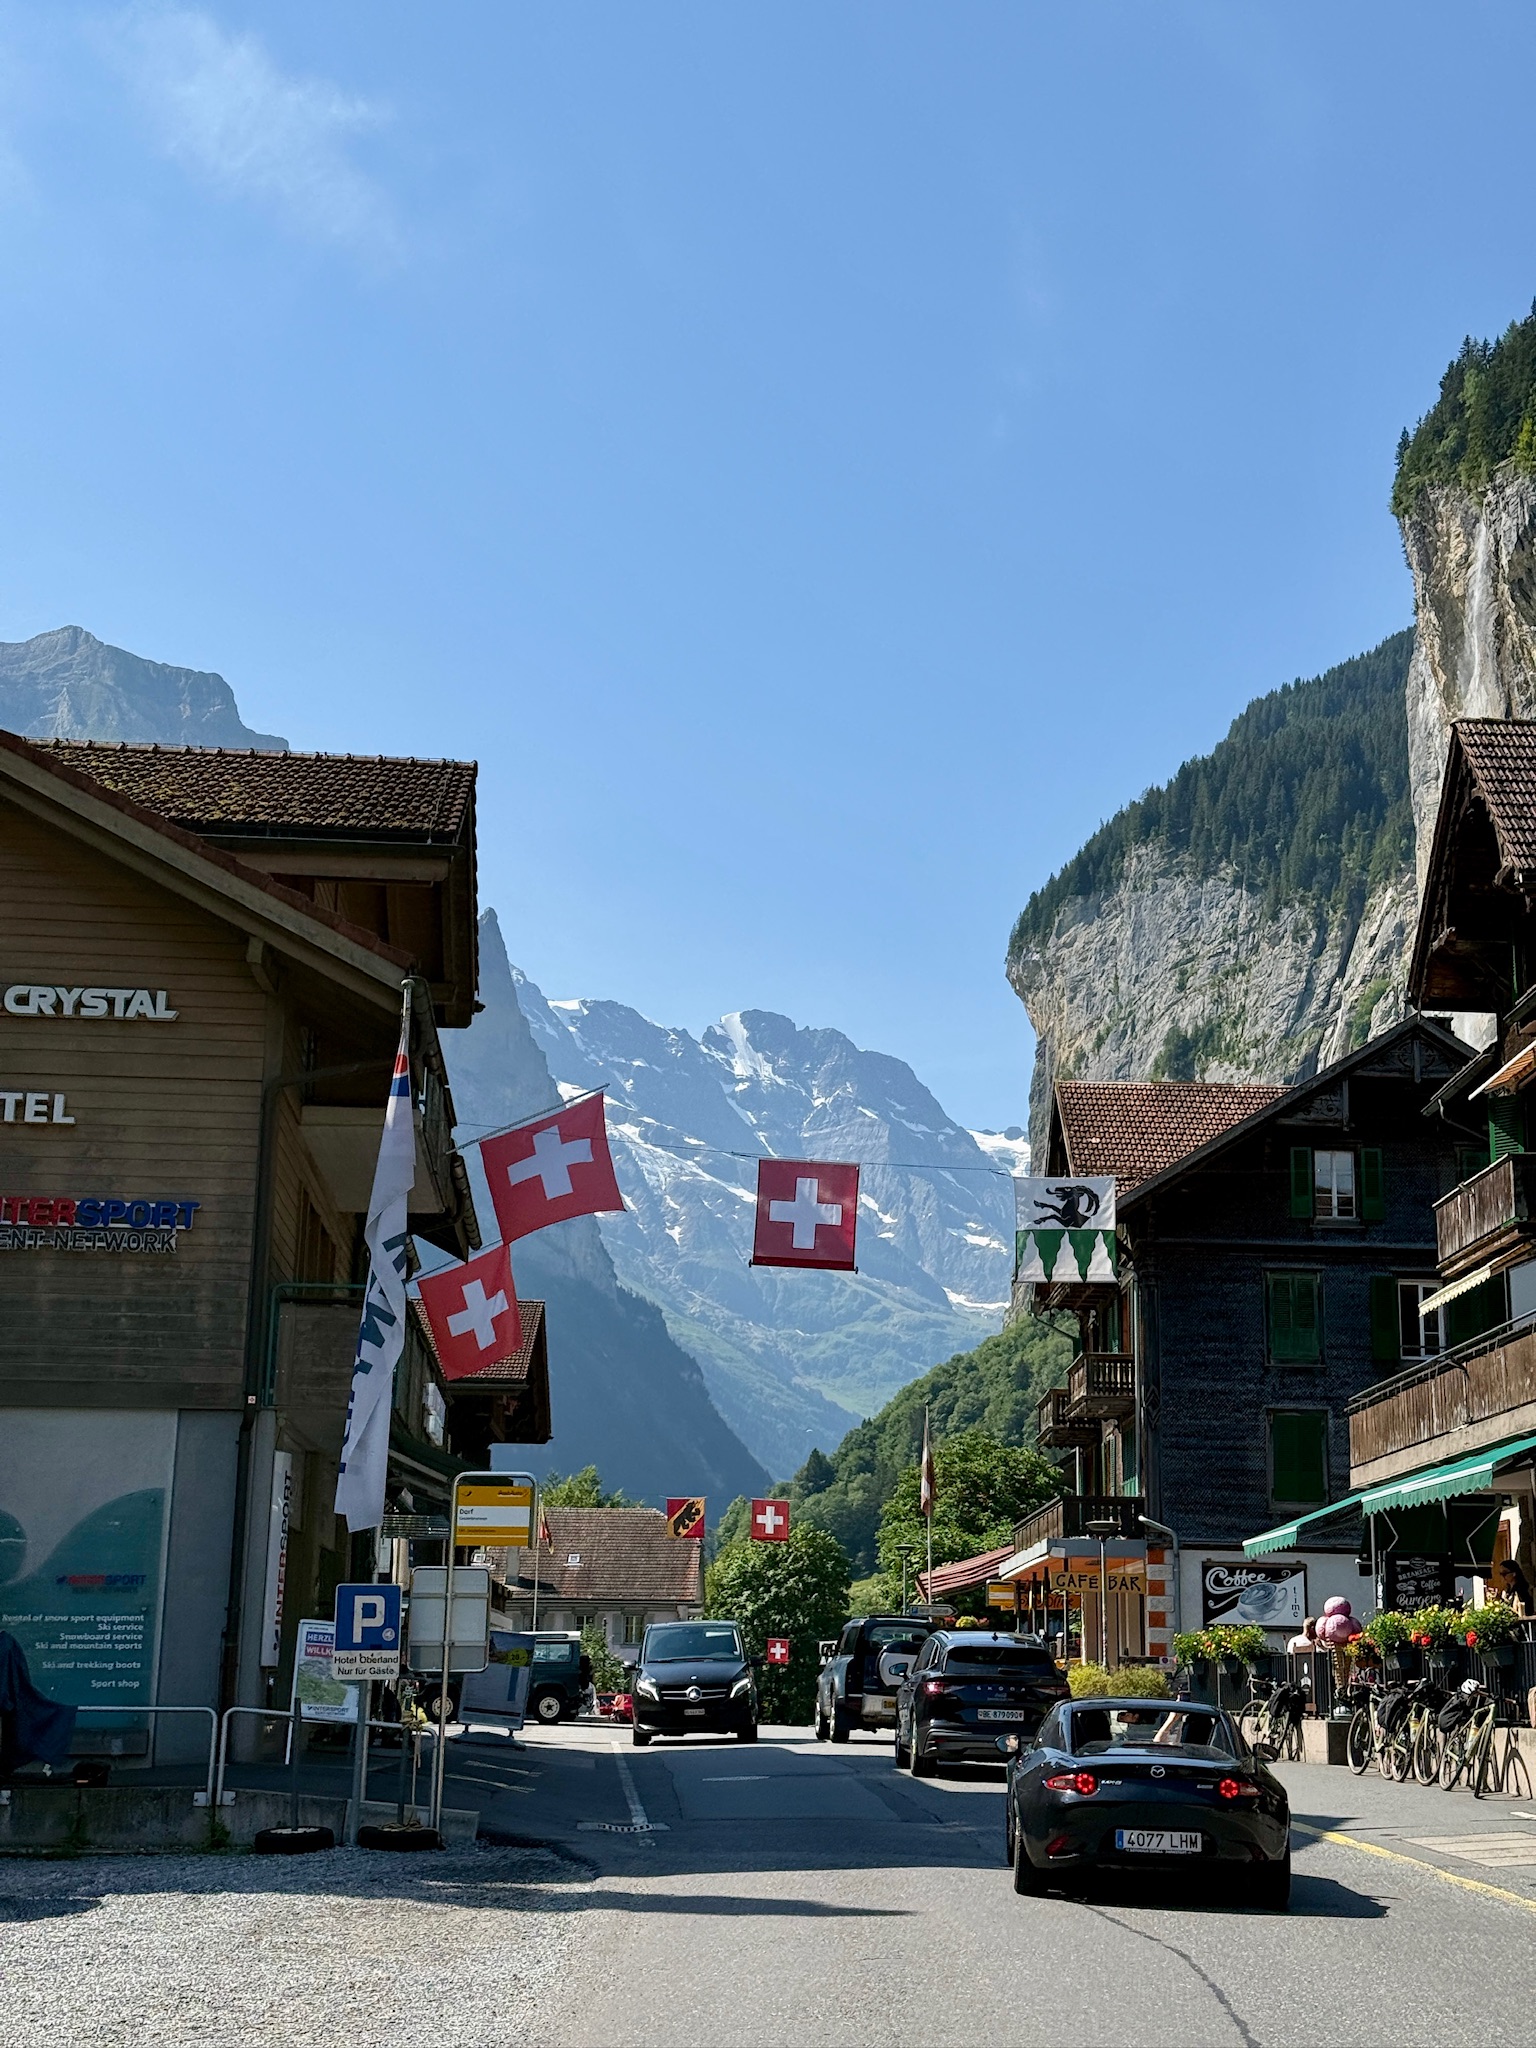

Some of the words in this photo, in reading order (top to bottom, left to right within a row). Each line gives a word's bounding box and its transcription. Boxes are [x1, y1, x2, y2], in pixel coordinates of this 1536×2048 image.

[4, 985, 179, 1021] CRYSTAL
[0, 1092, 76, 1124] TEL
[275, 1470, 292, 1625] INTERSPORT
[1056, 1574, 1099, 1589] CAFÉ
[1108, 1575, 1141, 1591] BAR
[1206, 1567, 1271, 1594] Coffee
[1421, 1579, 1441, 1590] Coffee
[1291, 1586, 1300, 1618] time
[1396, 1593, 1442, 1608] Burgers
[70, 1614, 94, 1623] sport
[96, 1614, 144, 1623] equipment
[352, 1595, 386, 1643] P
[307, 1633, 332, 1642] HERZL
[114, 1642, 142, 1650] sports
[76, 1661, 114, 1670] trekking
[115, 1661, 141, 1669] boots
[334, 1656, 356, 1664] Hotel
[360, 1655, 398, 1664] Oberland
[337, 1667, 352, 1675] Nur
[355, 1666, 366, 1675] für
[369, 1666, 395, 1675] Gäste
[91, 1680, 116, 1688] Sport
[118, 1680, 140, 1688] shop
[1127, 1832, 1164, 1848] 4077
[1170, 1834, 1198, 1849] LHM
